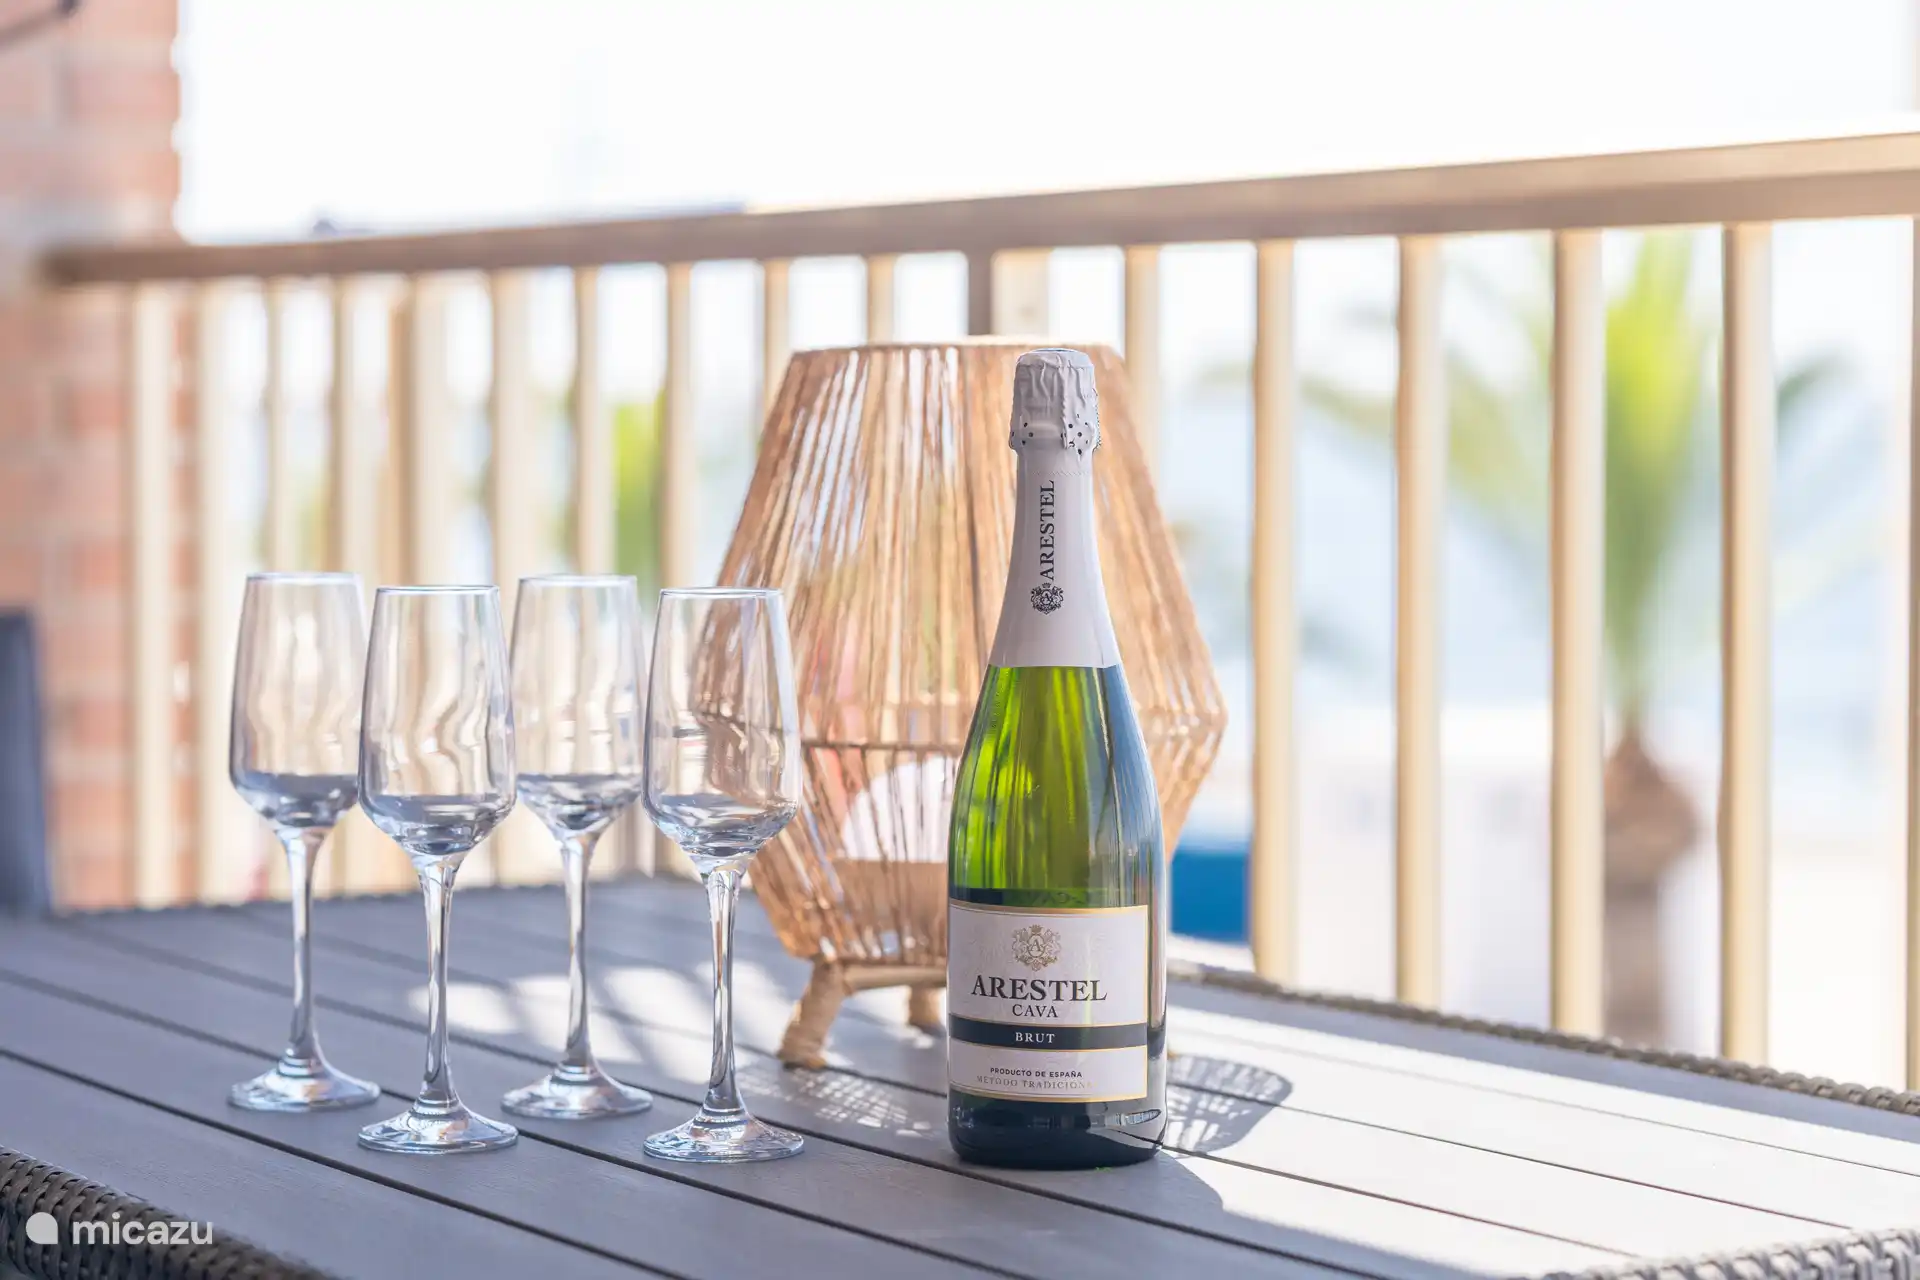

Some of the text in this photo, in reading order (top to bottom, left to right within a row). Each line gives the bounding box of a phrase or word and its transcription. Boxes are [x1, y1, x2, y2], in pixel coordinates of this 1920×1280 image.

[1040, 479, 1055, 581] ARESTEL
[1030, 939, 1041, 952] A
[971, 975, 1108, 1002] ARESTEL
[1012, 1003, 1058, 1018] CAVA
[1015, 1031, 1056, 1044] BRUT
[990, 1067, 1083, 1078] PRODUCTO DE ESPAÑA
